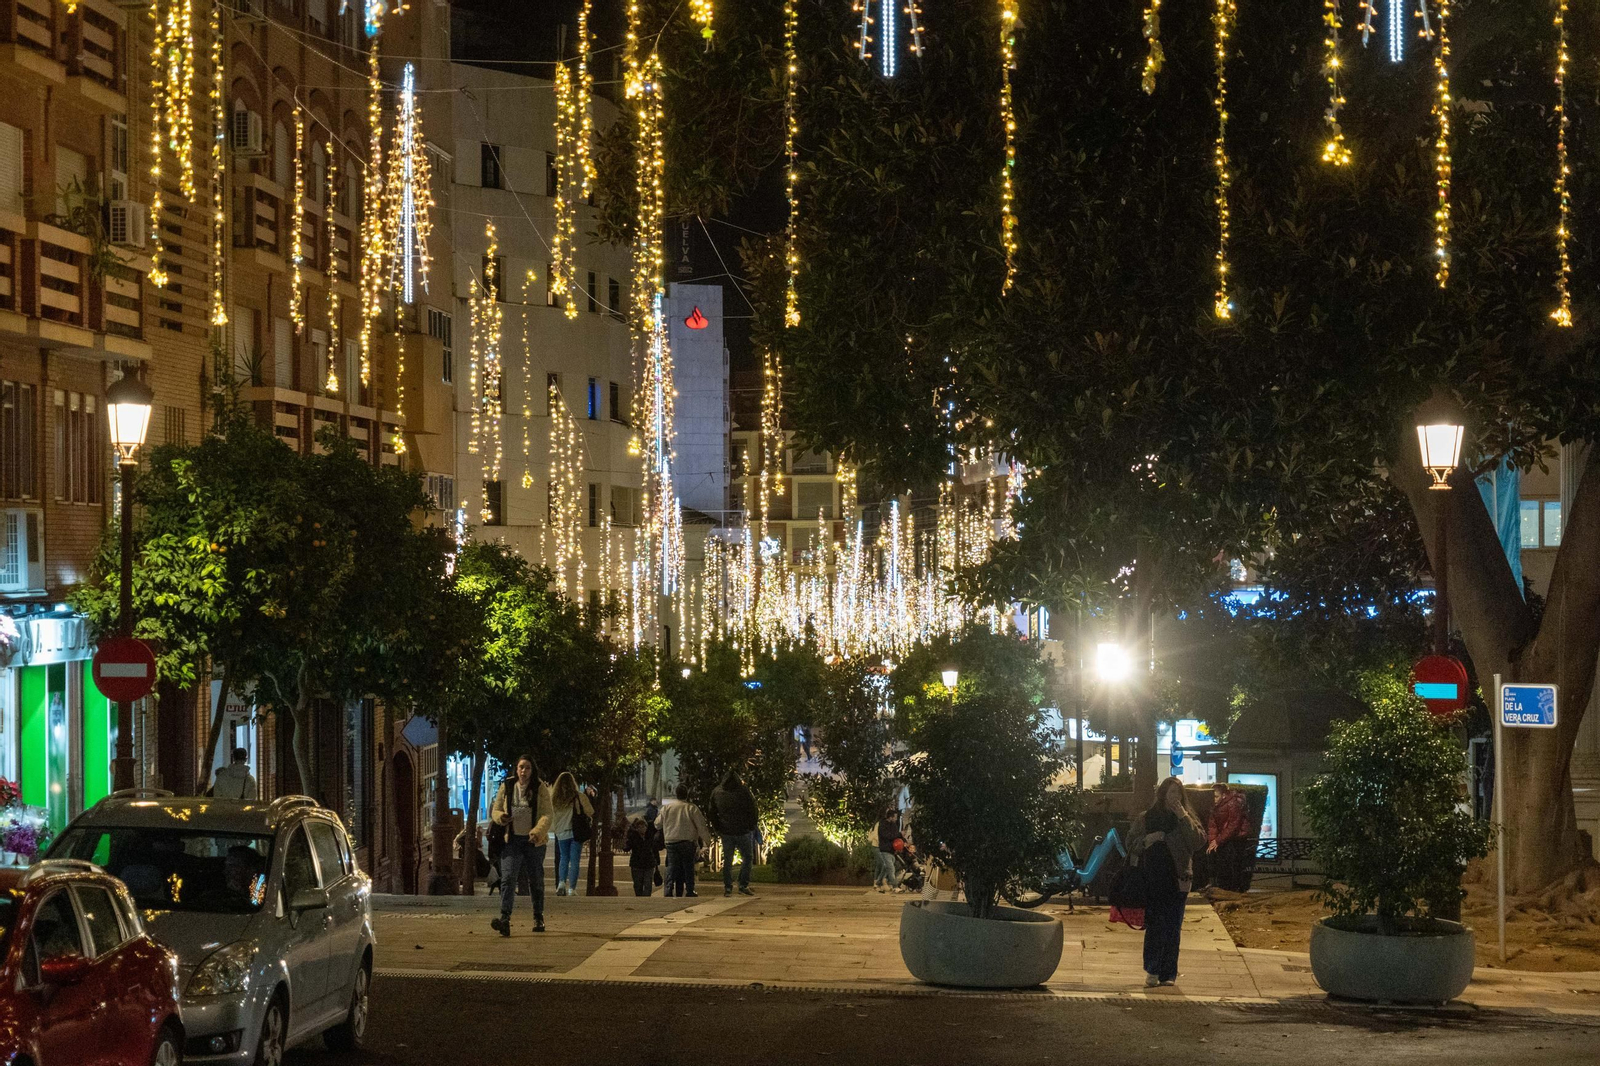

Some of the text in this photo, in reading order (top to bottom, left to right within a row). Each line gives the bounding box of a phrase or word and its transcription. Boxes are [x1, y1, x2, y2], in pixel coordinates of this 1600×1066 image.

[682, 222, 690, 262] UELVA
[1505, 702, 1523, 711] DE LA
[1505, 714, 1539, 722] VERA CRUZ
